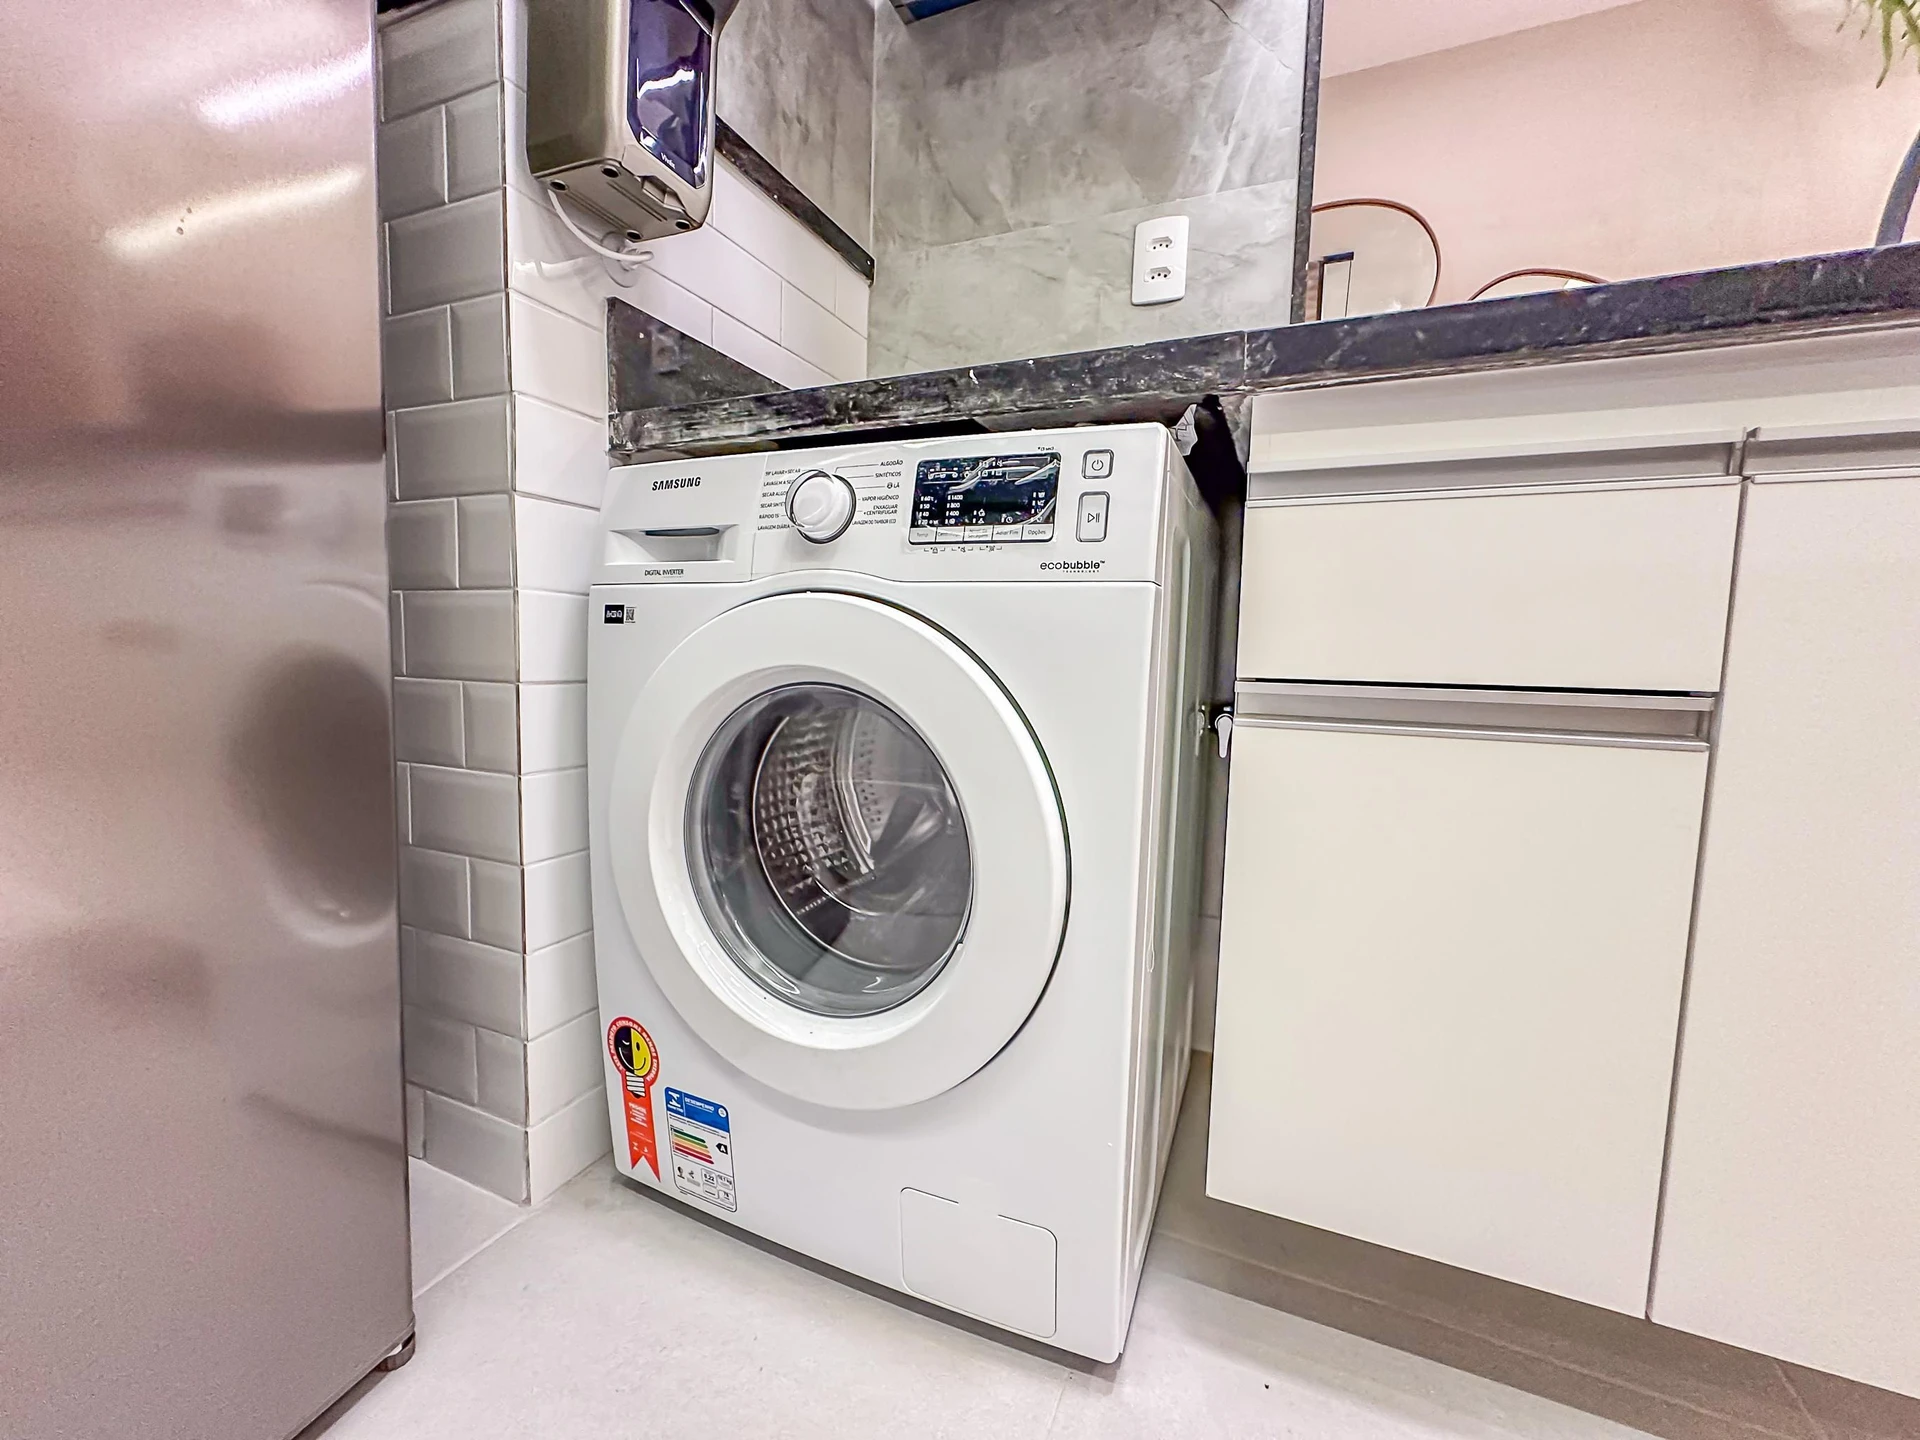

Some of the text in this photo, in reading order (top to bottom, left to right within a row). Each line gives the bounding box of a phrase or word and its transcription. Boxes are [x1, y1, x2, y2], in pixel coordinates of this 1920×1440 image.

[652, 476, 701, 491] SAMSUNG
[662, 568, 684, 576] INVERTER
[720, 1144, 728, 1153] A
